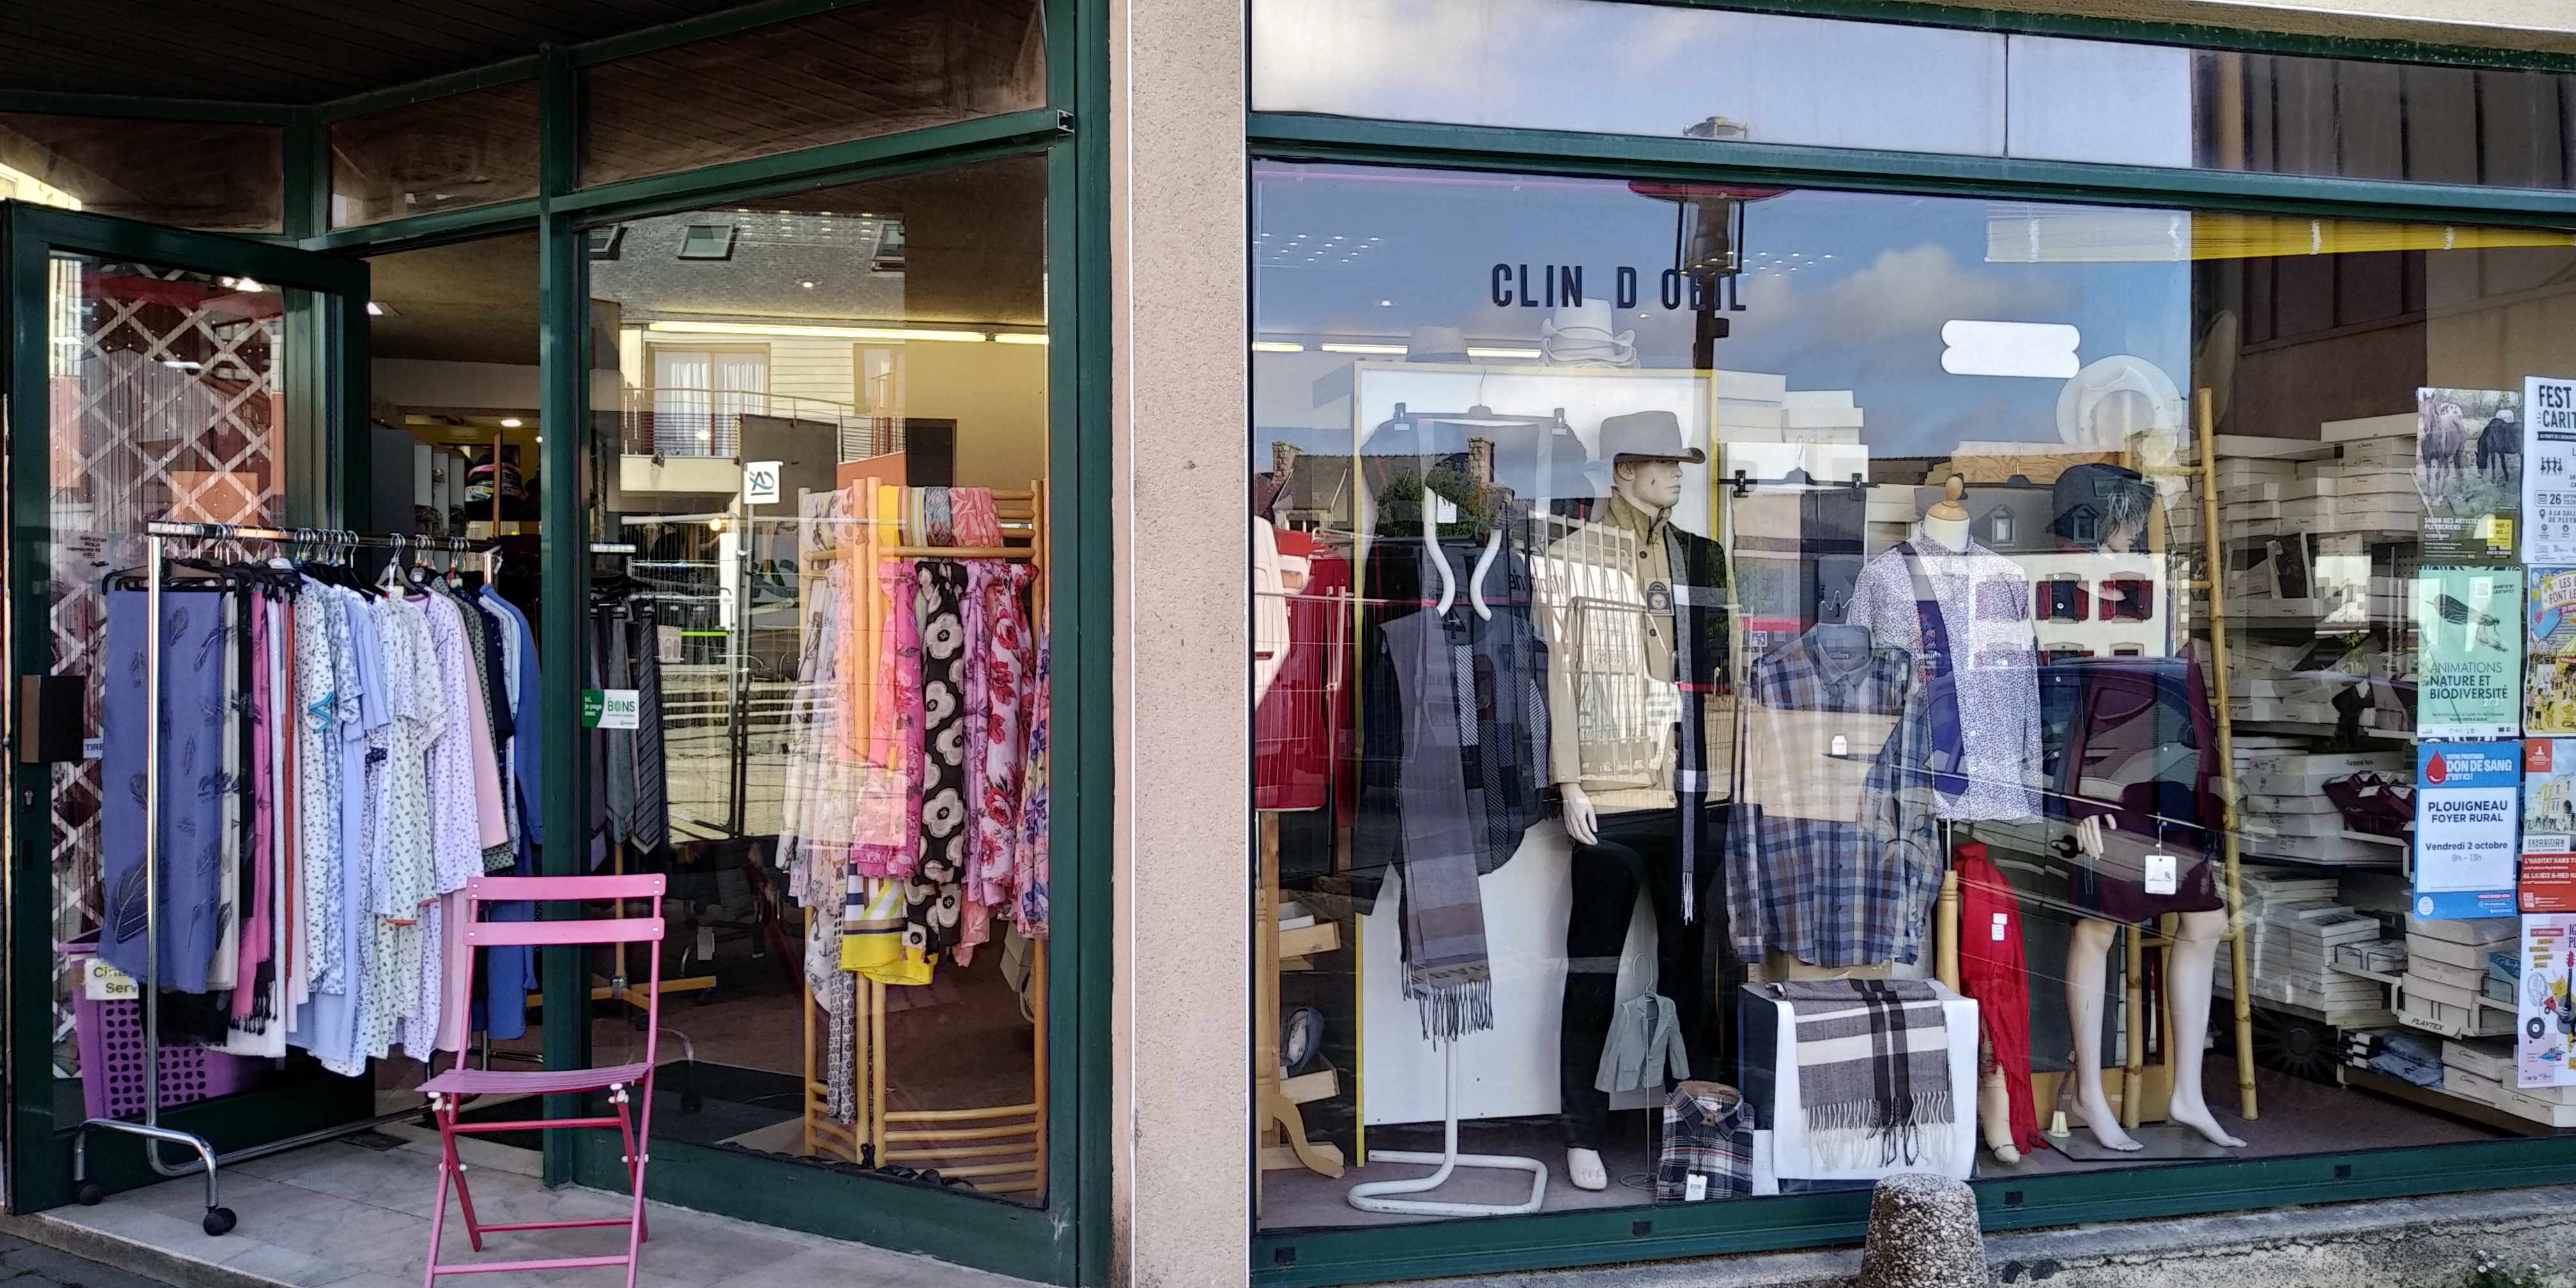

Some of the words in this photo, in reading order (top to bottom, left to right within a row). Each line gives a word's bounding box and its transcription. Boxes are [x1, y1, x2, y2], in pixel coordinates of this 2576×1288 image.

[1491, 263, 1583, 308] CLIN
[1616, 266, 1637, 309] D
[1661, 268, 1747, 312] OEIL
[2538, 385, 2572, 409] FEST
[2549, 493, 2562, 505] 26
[2559, 577, 2572, 588] LES
[2549, 589, 2567, 604] FONT
[2430, 661, 2503, 673] ANIMATIONS
[2430, 675, 2475, 686] NATURE
[2478, 675, 2490, 686] ET
[2430, 684, 2508, 699] BIODIVERSITÉ
[607, 700, 636, 712] BONS
[2446, 760, 2469, 772] DON
[2469, 760, 2483, 772] DE
[2483, 759, 2513, 772] SANG
[2428, 800, 2508, 812] PLOUIGNEAU
[2431, 814, 2466, 823] FOYER
[2469, 813, 2503, 823] RURAL
[2425, 841, 2465, 850] Vendredi
[2474, 841, 2508, 850] octobre
[2451, 854, 2462, 862] 9h
[2469, 854, 2482, 862] 13h
[2411, 1018, 2444, 1031] PLAYTEX
